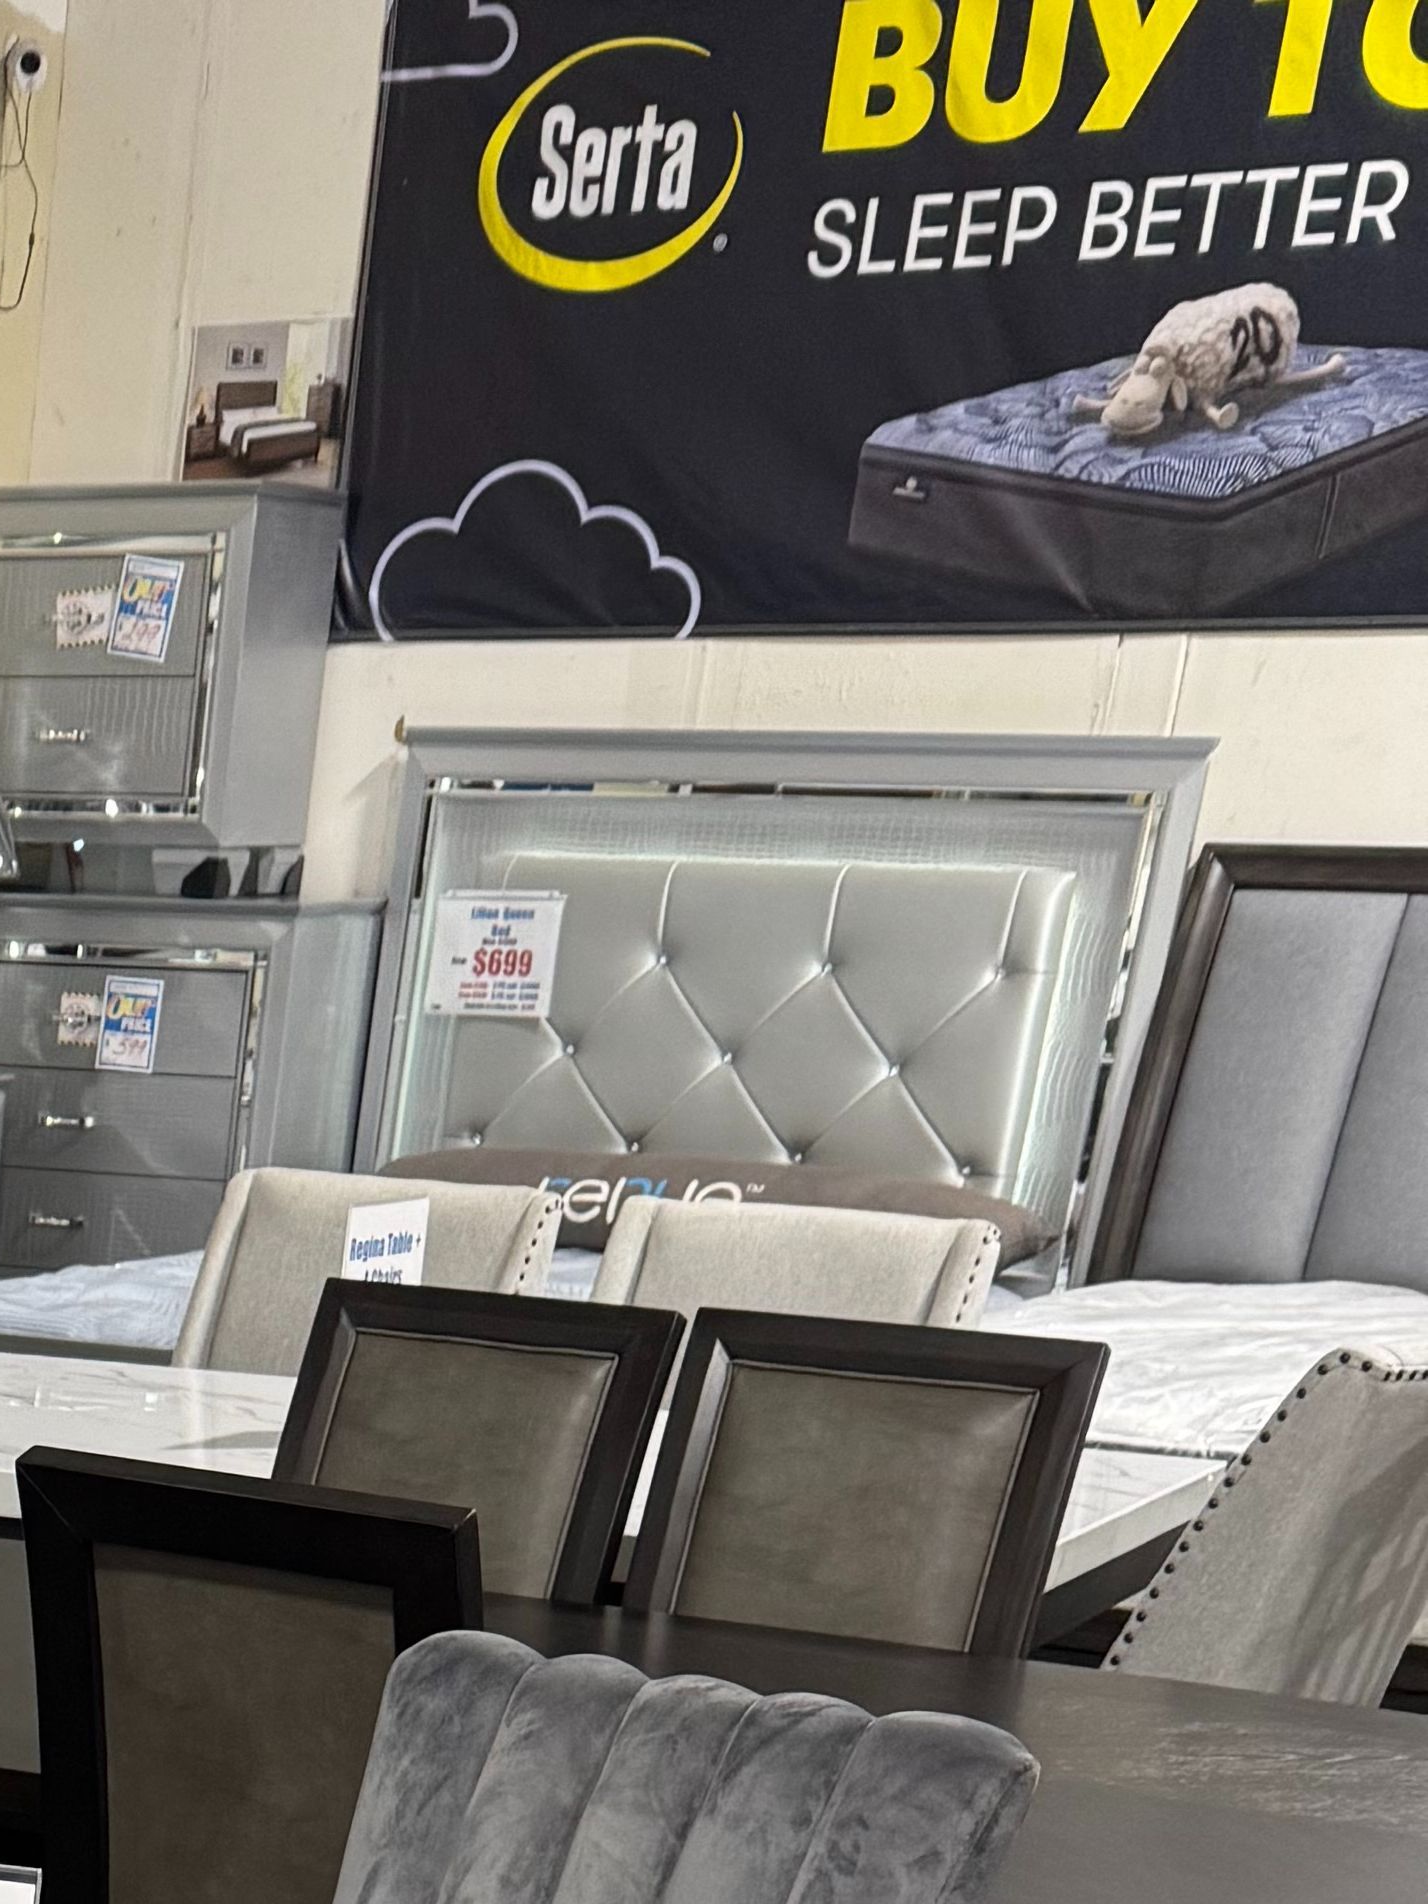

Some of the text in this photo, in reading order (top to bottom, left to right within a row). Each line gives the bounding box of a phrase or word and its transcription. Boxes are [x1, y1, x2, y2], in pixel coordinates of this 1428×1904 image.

[822, 0, 1196, 153] BUY
[530, 102, 698, 221] Serta
[806, 160, 1411, 279] SLEEP BETTER
[472, 947, 534, 977] $699
[349, 1235, 385, 1262] Regina
[387, 1231, 414, 1256] Table
